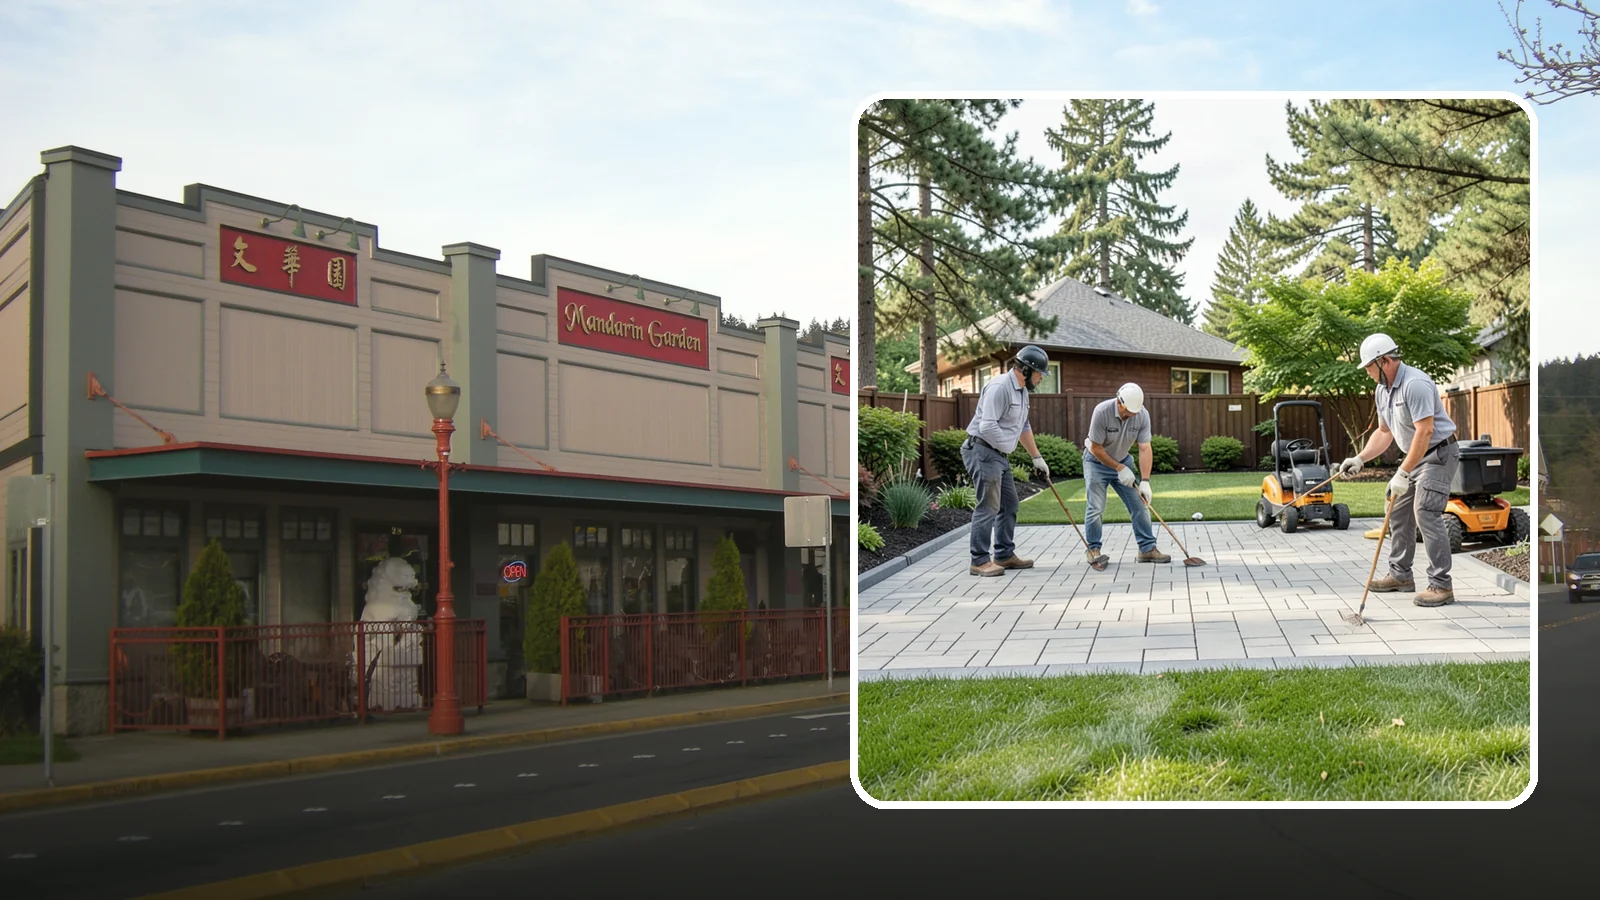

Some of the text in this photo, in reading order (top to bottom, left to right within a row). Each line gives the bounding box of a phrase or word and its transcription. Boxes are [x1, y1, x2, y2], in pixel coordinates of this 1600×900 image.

[231, 236, 346, 292] 文華園
[564, 301, 701, 353] Mandarin Garden
[503, 565, 526, 578] OPEN
